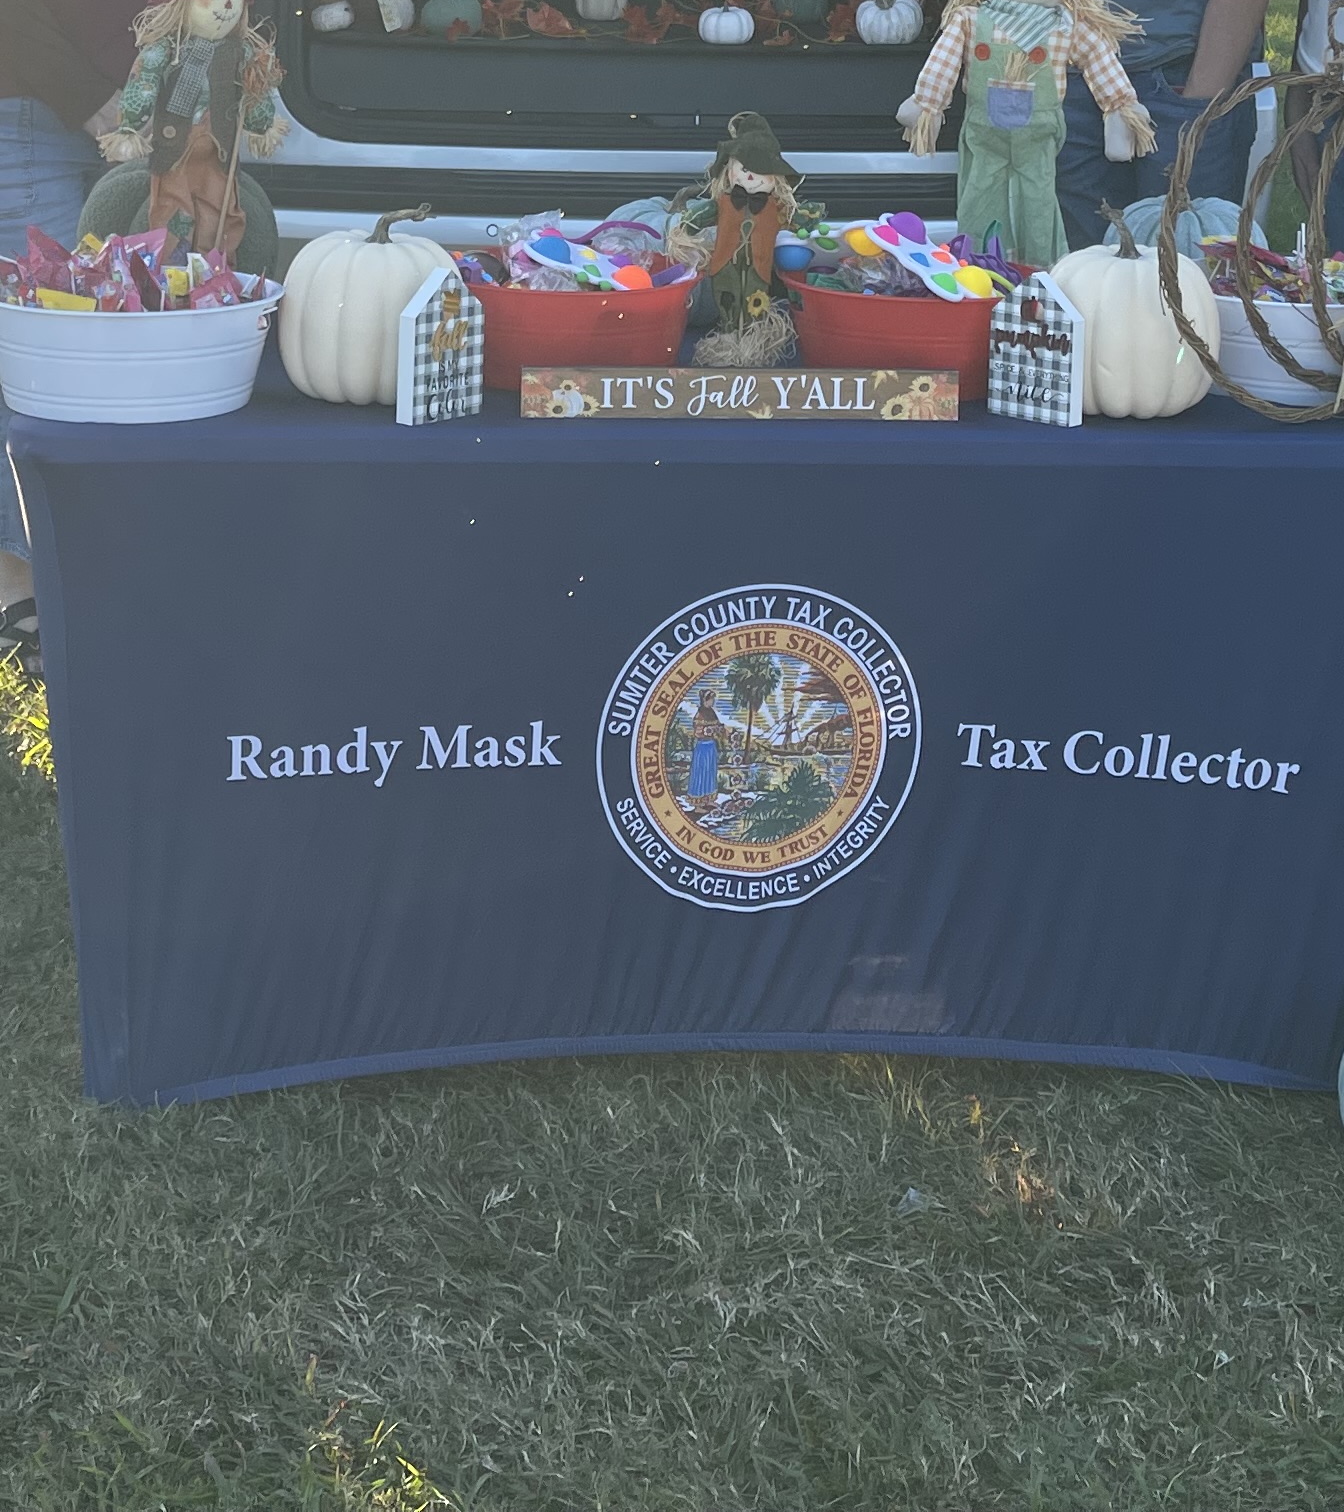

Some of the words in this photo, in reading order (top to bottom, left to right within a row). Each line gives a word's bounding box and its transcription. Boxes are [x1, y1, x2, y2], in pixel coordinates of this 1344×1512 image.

[599, 376, 675, 410] IT'S
[685, 374, 760, 417] Fall
[771, 376, 876, 411] Y'ALL
[694, 641, 724, 667] OF
[728, 630, 778, 652] THE
[785, 633, 846, 674] STATE
[607, 641, 676, 737] SUMTER
[673, 595, 778, 647] COUNTY
[785, 595, 834, 630] TAX
[831, 615, 912, 740] COLLECTOR
[842, 672, 869, 698] OF
[655, 669, 695, 719] SEAL
[225, 725, 403, 788] Randy
[415, 719, 563, 771] Mask
[642, 724, 667, 800] GREAT
[841, 703, 877, 801] FLORIDA
[956, 721, 1051, 772] Tax
[1062, 729, 1301, 795] Collector
[615, 796, 673, 871] SERVICE
[677, 864, 801, 901] EXCELLENCE
[811, 794, 891, 881] INTEGRITY
[675, 824, 695, 846] IN
[697, 840, 736, 863] GOD
[742, 849, 772, 865] WE
[776, 822, 830, 861] TRUST
